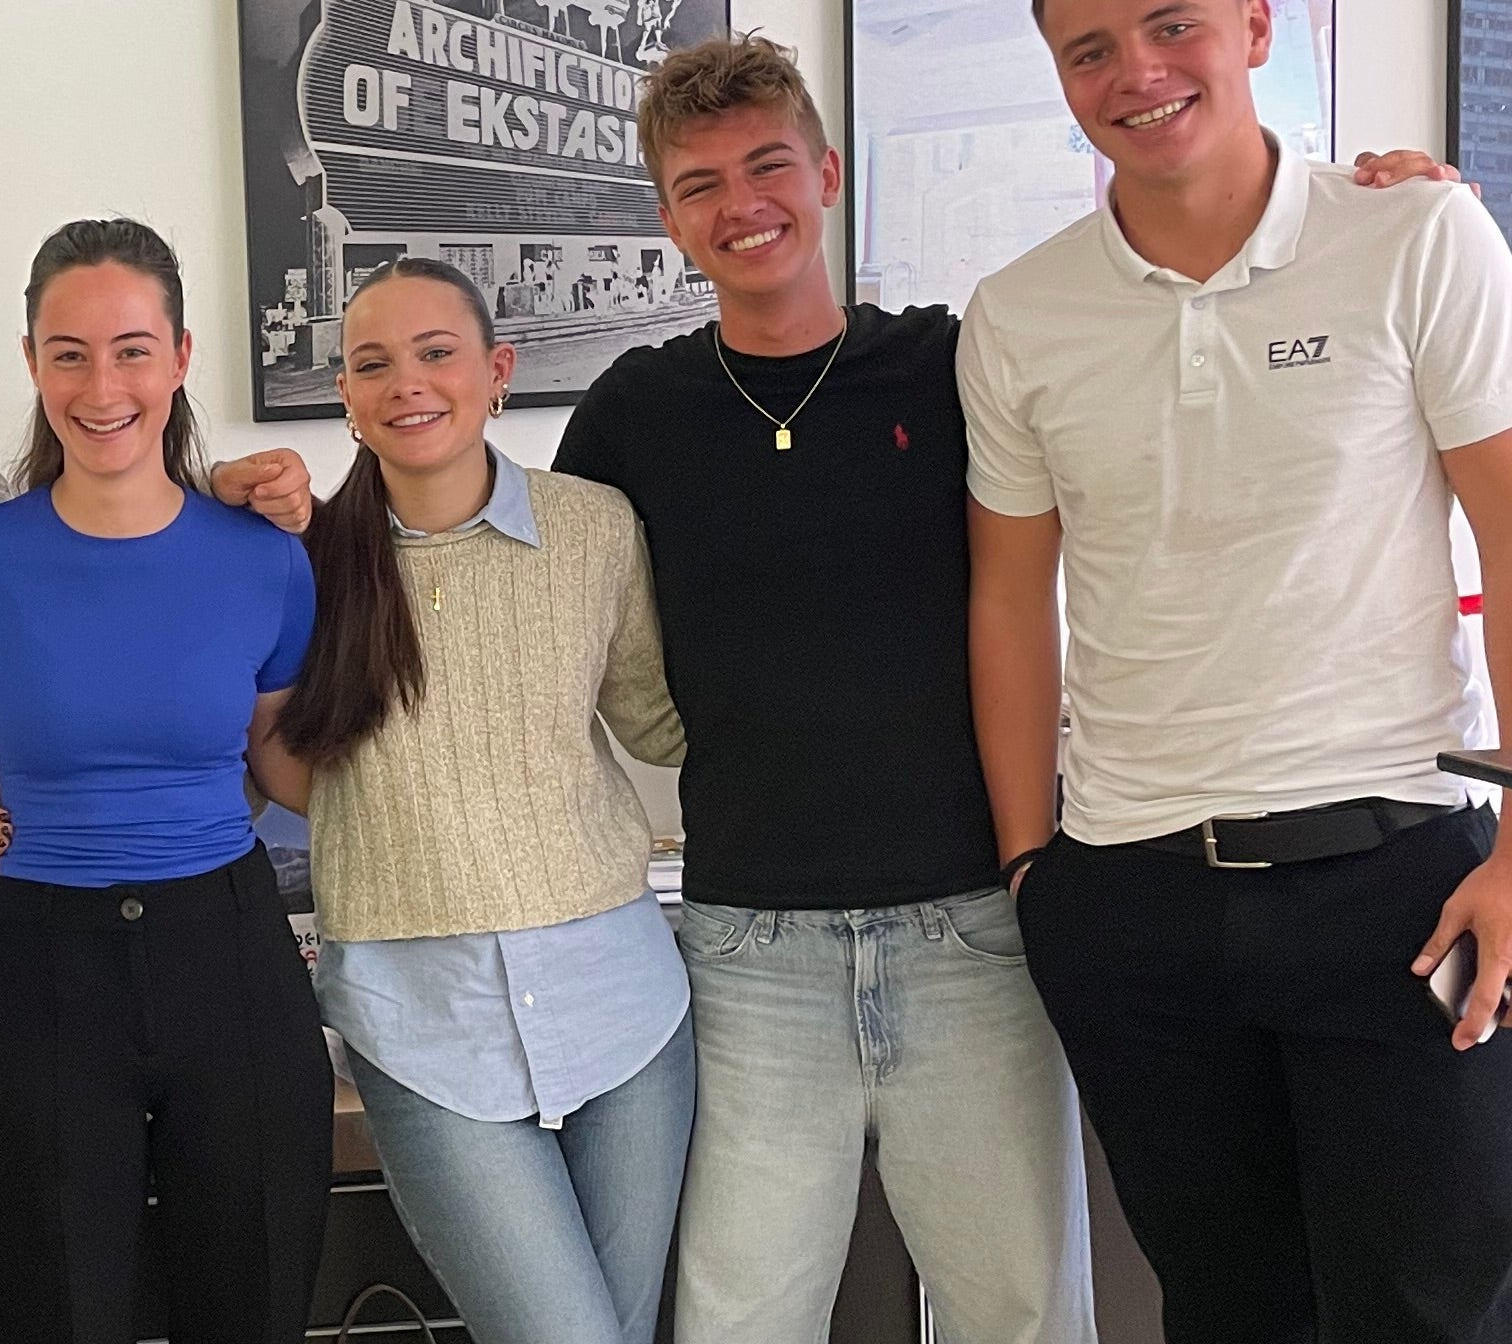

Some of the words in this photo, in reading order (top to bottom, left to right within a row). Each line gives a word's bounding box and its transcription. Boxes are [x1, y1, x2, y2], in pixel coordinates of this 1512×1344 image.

[343, 63, 412, 131] OF
[446, 79, 647, 168] EKSTASI
[1268, 335, 1329, 363] EA7
